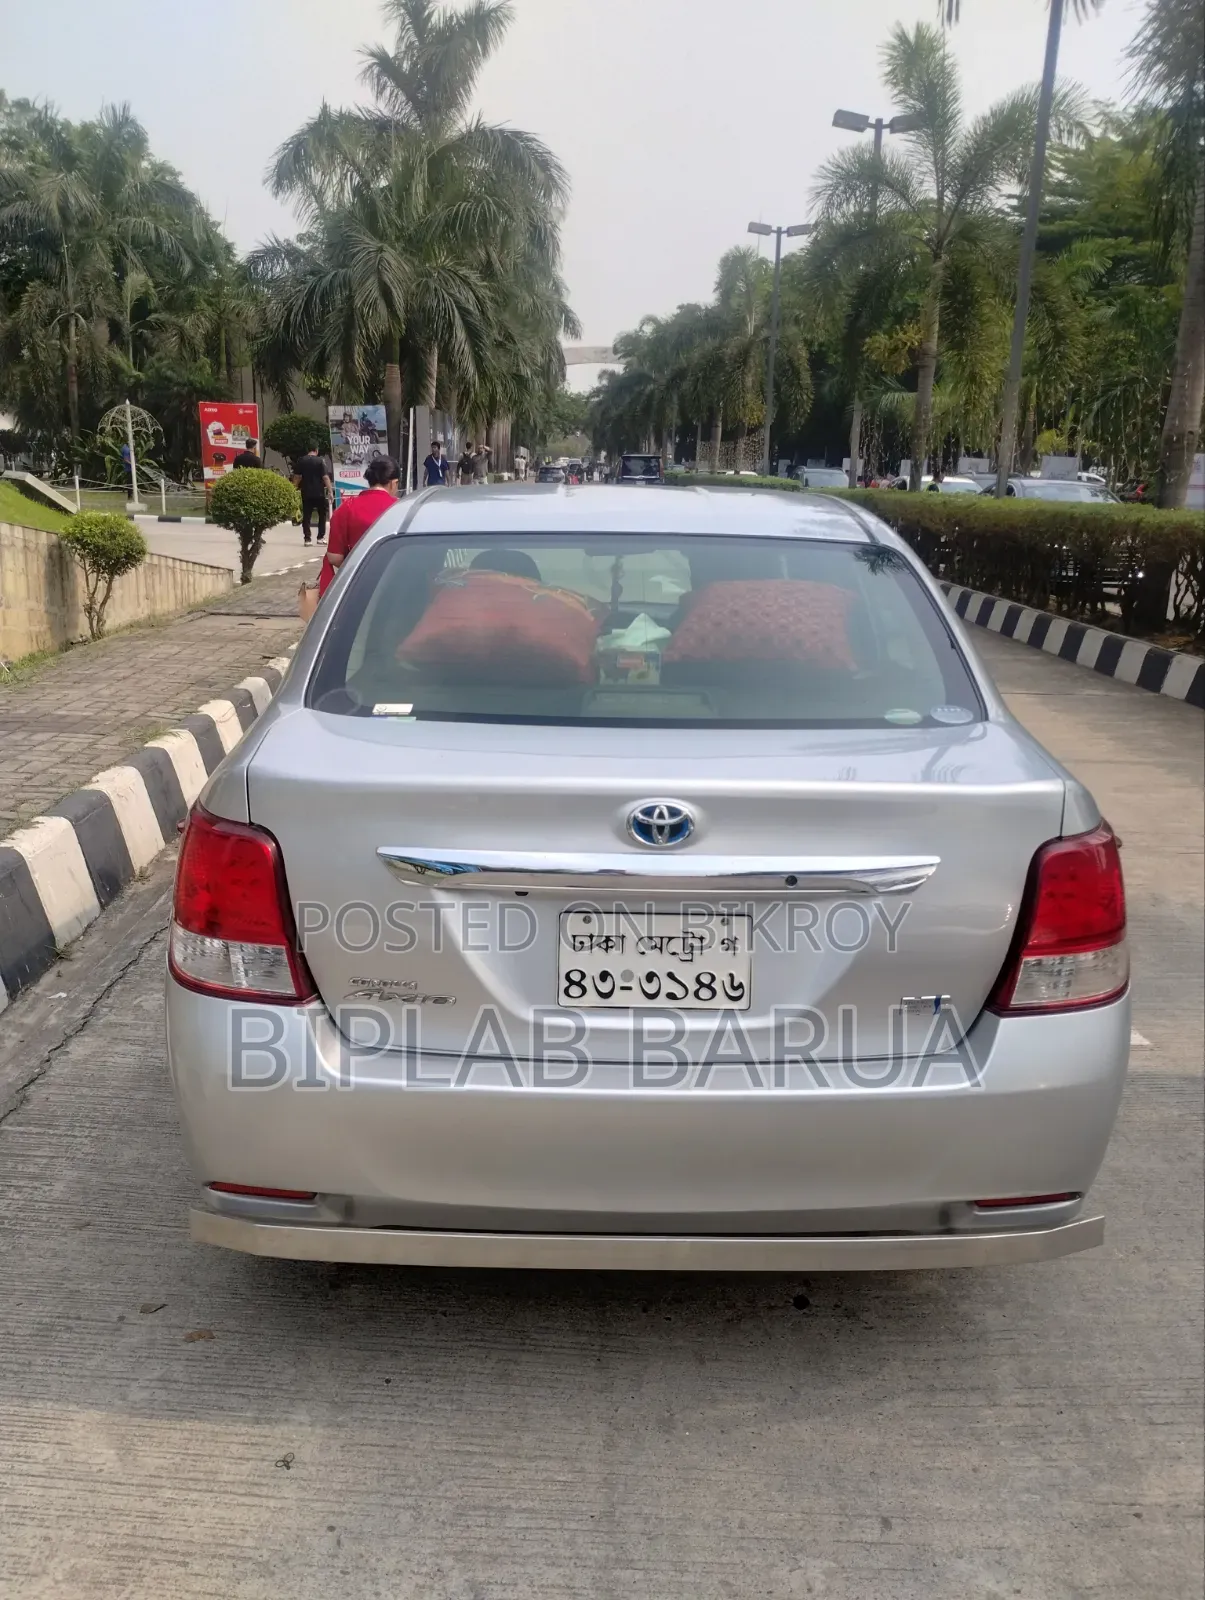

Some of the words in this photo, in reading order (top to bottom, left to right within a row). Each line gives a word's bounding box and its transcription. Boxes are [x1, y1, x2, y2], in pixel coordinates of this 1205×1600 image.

[348, 436, 371, 444] YOUR
[351, 445, 369, 453] WAY
[572, 933, 626, 954] ঢাকা
[636, 931, 705, 962] মেট্রো
[720, 935, 739, 956] গ
[563, 969, 745, 1002] ৪৩-৩১৪৬
